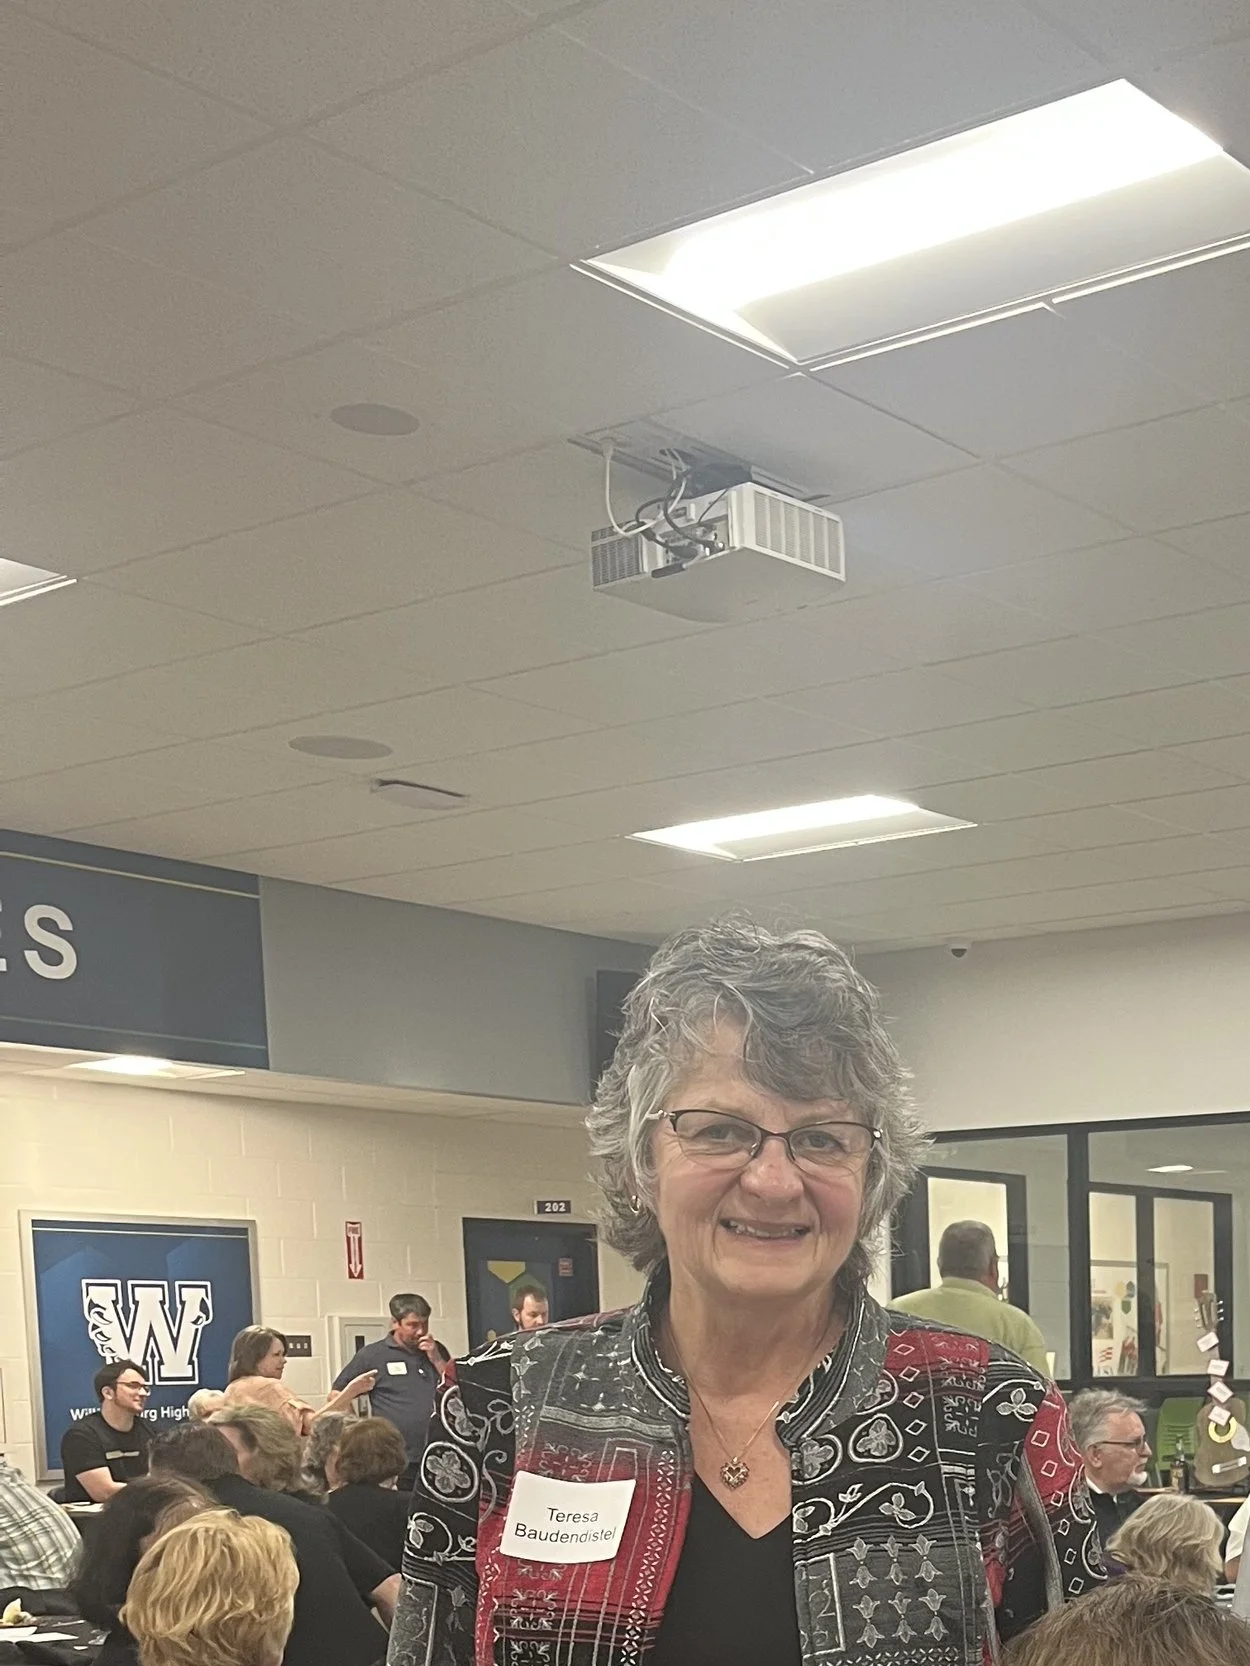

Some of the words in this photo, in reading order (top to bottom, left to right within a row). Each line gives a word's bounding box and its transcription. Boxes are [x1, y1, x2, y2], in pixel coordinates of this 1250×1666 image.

[0, 900, 78, 980] S
[545, 1202, 566, 1212] 202
[82, 1279, 213, 1386] W
[161, 1406, 189, 1421] High
[547, 1507, 599, 1523] Teresa
[514, 1523, 617, 1544] Baudendistel
